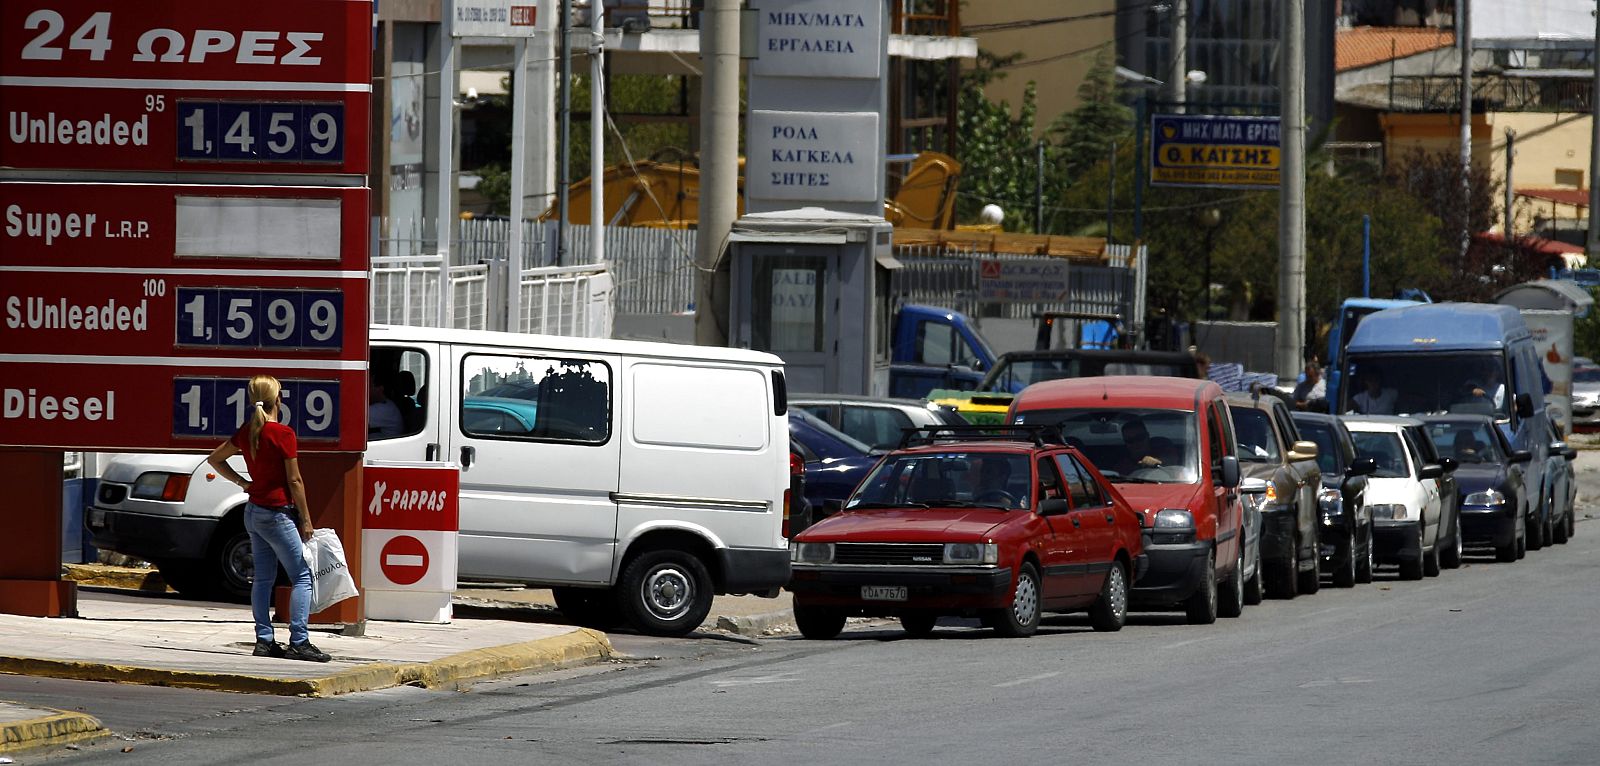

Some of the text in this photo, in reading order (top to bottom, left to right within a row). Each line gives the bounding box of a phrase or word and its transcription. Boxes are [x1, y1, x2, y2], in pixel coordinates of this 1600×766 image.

[768, 12, 864, 27] ΜΗΧ/ΜΑΤΑ
[21, 8, 324, 66] 24 ΩΡΕΣ
[768, 39, 854, 53] ΕΡΓΑΛΕΙΑ
[9, 95, 165, 146] Unleaded 95
[184, 108, 338, 154] 1,459
[772, 126, 818, 140] ΡΟΛΑ
[772, 149, 854, 164] ΚΑΓΚΕΛΑ
[1191, 147, 1272, 164] ΚΑΤΣΗΣ
[771, 172, 829, 187] ΣΗΤΕΣ
[6, 205, 149, 245] Super L.R.P.
[6, 278, 166, 332] S.Unleaded 100
[184, 294, 338, 341] 1,599
[3, 388, 114, 421] Diesel
[368, 480, 447, 516] X-PAPPAS
